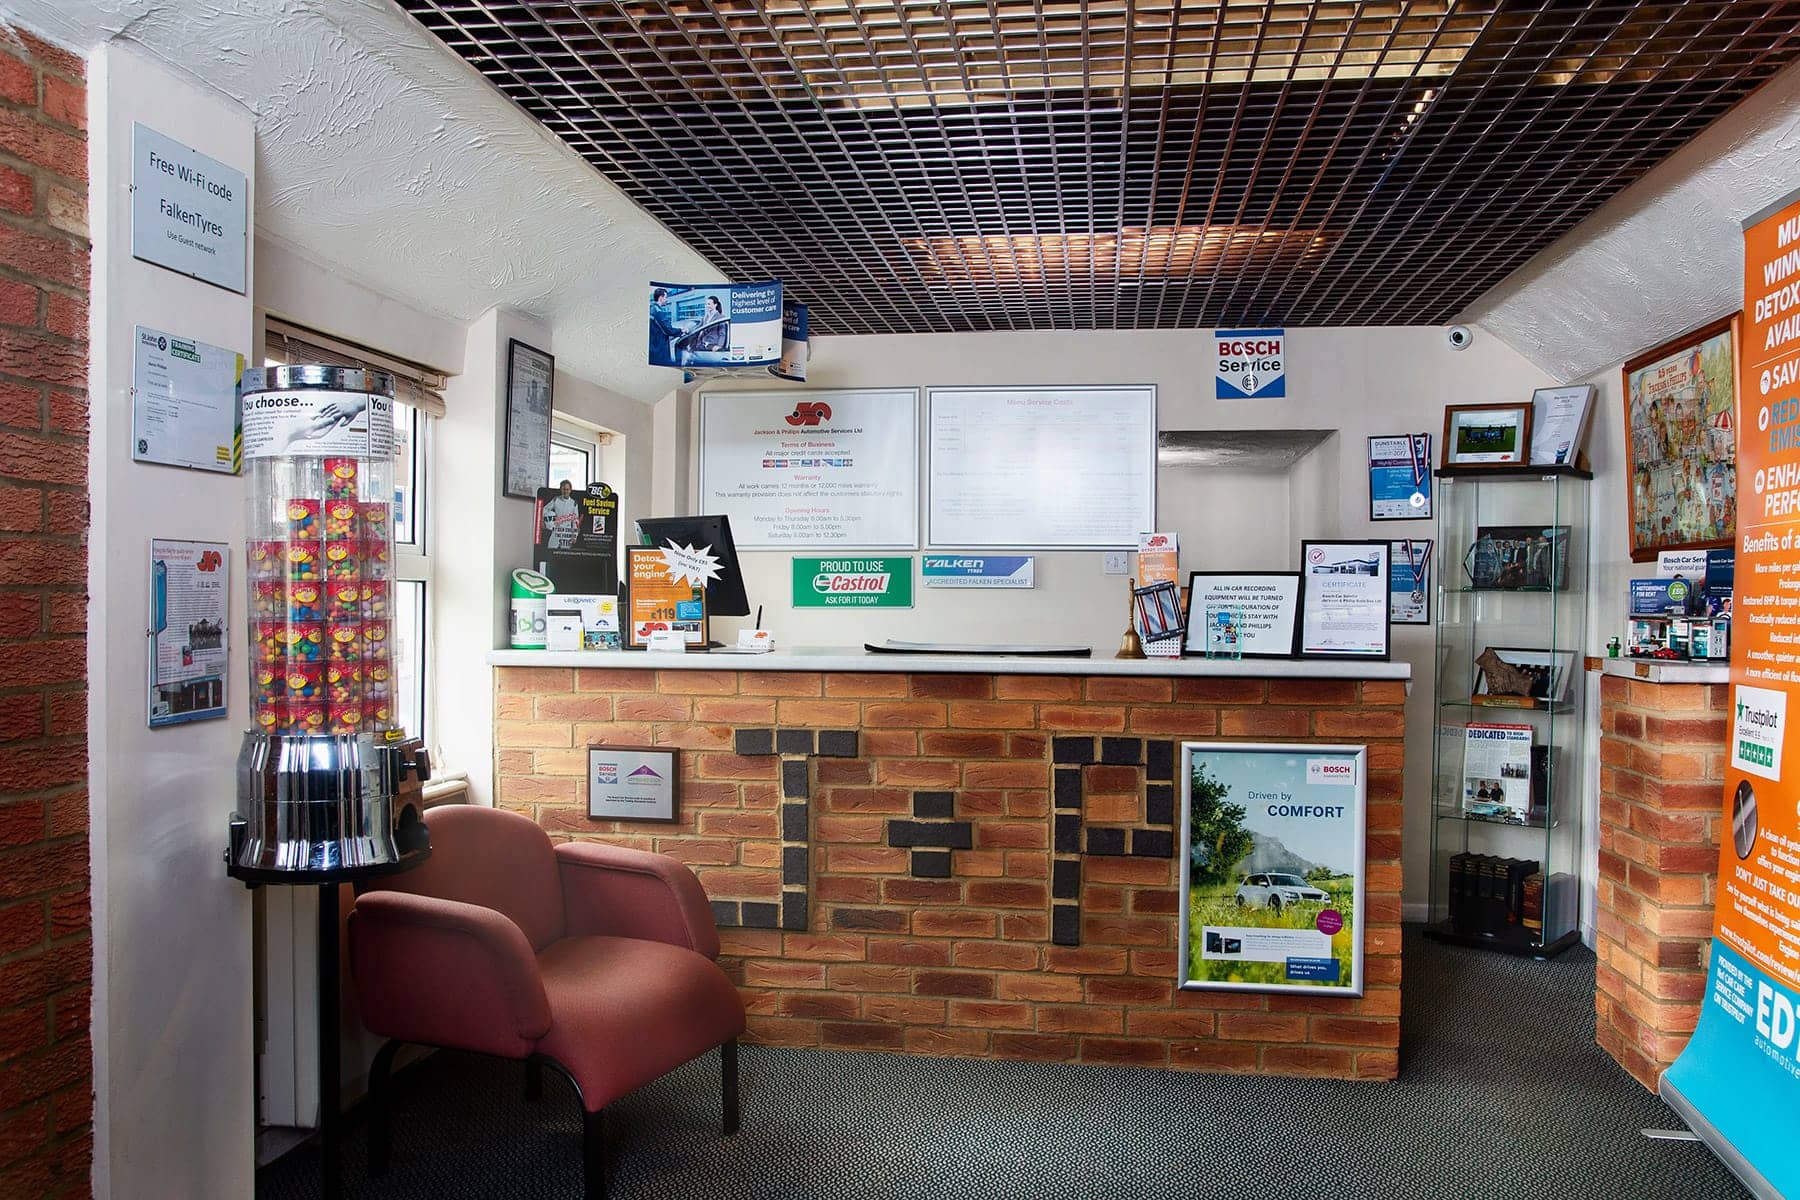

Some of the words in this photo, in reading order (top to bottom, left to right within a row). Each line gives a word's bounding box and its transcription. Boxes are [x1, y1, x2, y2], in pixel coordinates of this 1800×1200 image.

[150, 152, 175, 176] Free
[178, 164, 205, 190] Wi-Fi
[208, 180, 232, 202] code
[160, 198, 223, 238] FalkenTyres
[166, 230, 178, 242] Use
[178, 236, 200, 248] Guest
[199, 241, 216, 256] network
[732, 290, 766, 298] Delivering
[1755, 280, 1800, 323] DETOX
[1219, 340, 1280, 356] BOSCH
[1219, 358, 1280, 372] Service
[1772, 359, 1800, 389] SAV
[256, 396, 313, 408] choose...
[372, 398, 387, 412] You
[588, 506, 610, 515] Service
[596, 499, 615, 508] Saving
[1744, 532, 1779, 553] Benefits
[1781, 528, 1793, 550] of
[820, 561, 850, 572] PROUD
[852, 561, 864, 572] TO
[865, 561, 884, 572] USE
[926, 559, 983, 568] FALKEN
[1768, 562, 1781, 572] miles
[831, 574, 885, 591] Castrol
[825, 596, 838, 604] ASK
[1745, 706, 1777, 728] Trustpilot
[1468, 730, 1505, 739] DEDICATED
[1248, 791, 1277, 800] Driven
[1281, 792, 1292, 801] by
[1268, 805, 1344, 818] COMFORT
[1736, 866, 1752, 884] DON'T
[1752, 875, 1768, 892] JUST
[1769, 882, 1786, 902] TAKE
